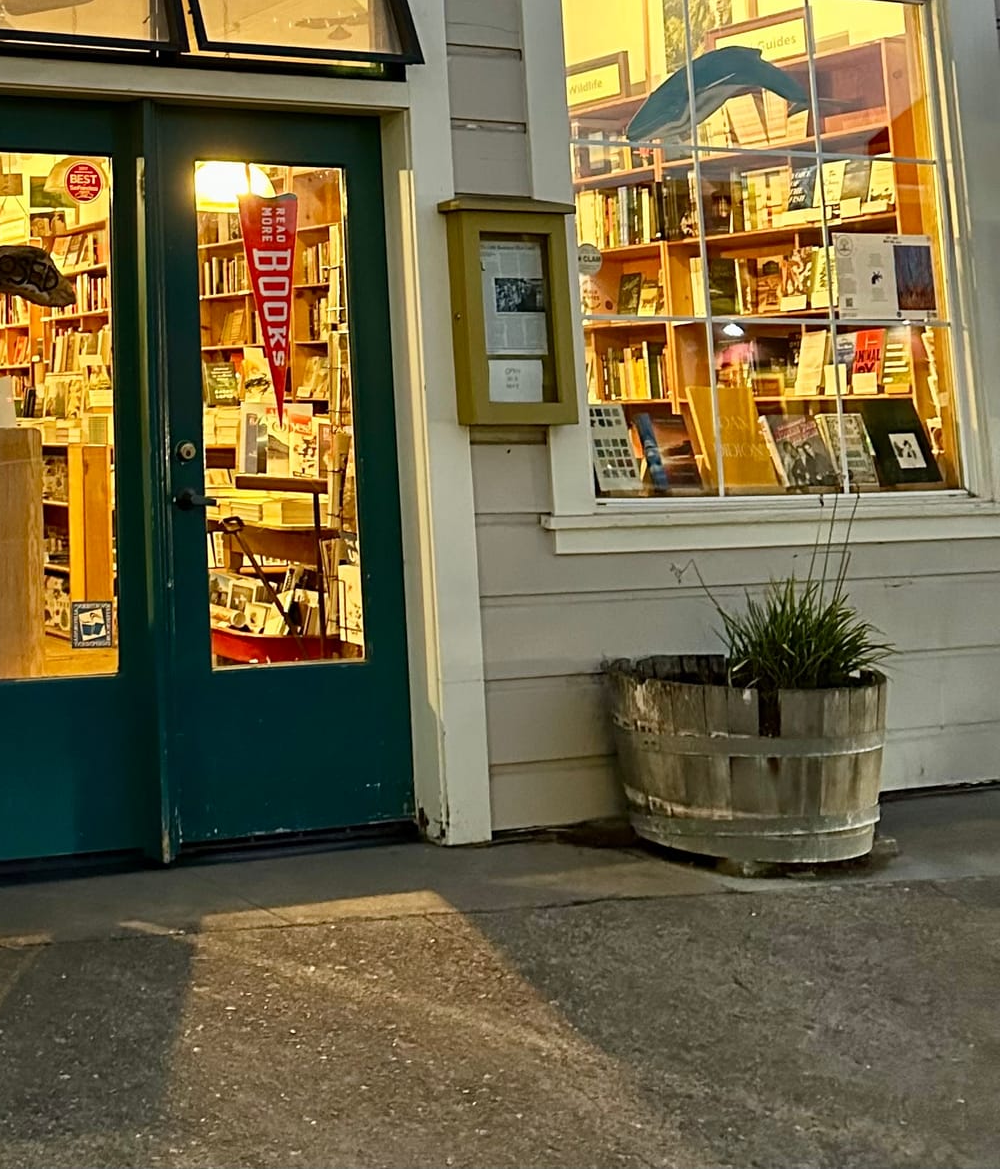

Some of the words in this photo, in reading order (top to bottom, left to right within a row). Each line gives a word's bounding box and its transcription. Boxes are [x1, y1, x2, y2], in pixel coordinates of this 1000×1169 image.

[569, 77, 603, 95] Wildlife
[69, 174, 98, 184] BEST
[261, 207, 272, 242] MORE
[276, 207, 286, 243] READ
[252, 248, 291, 367] BOOKS
